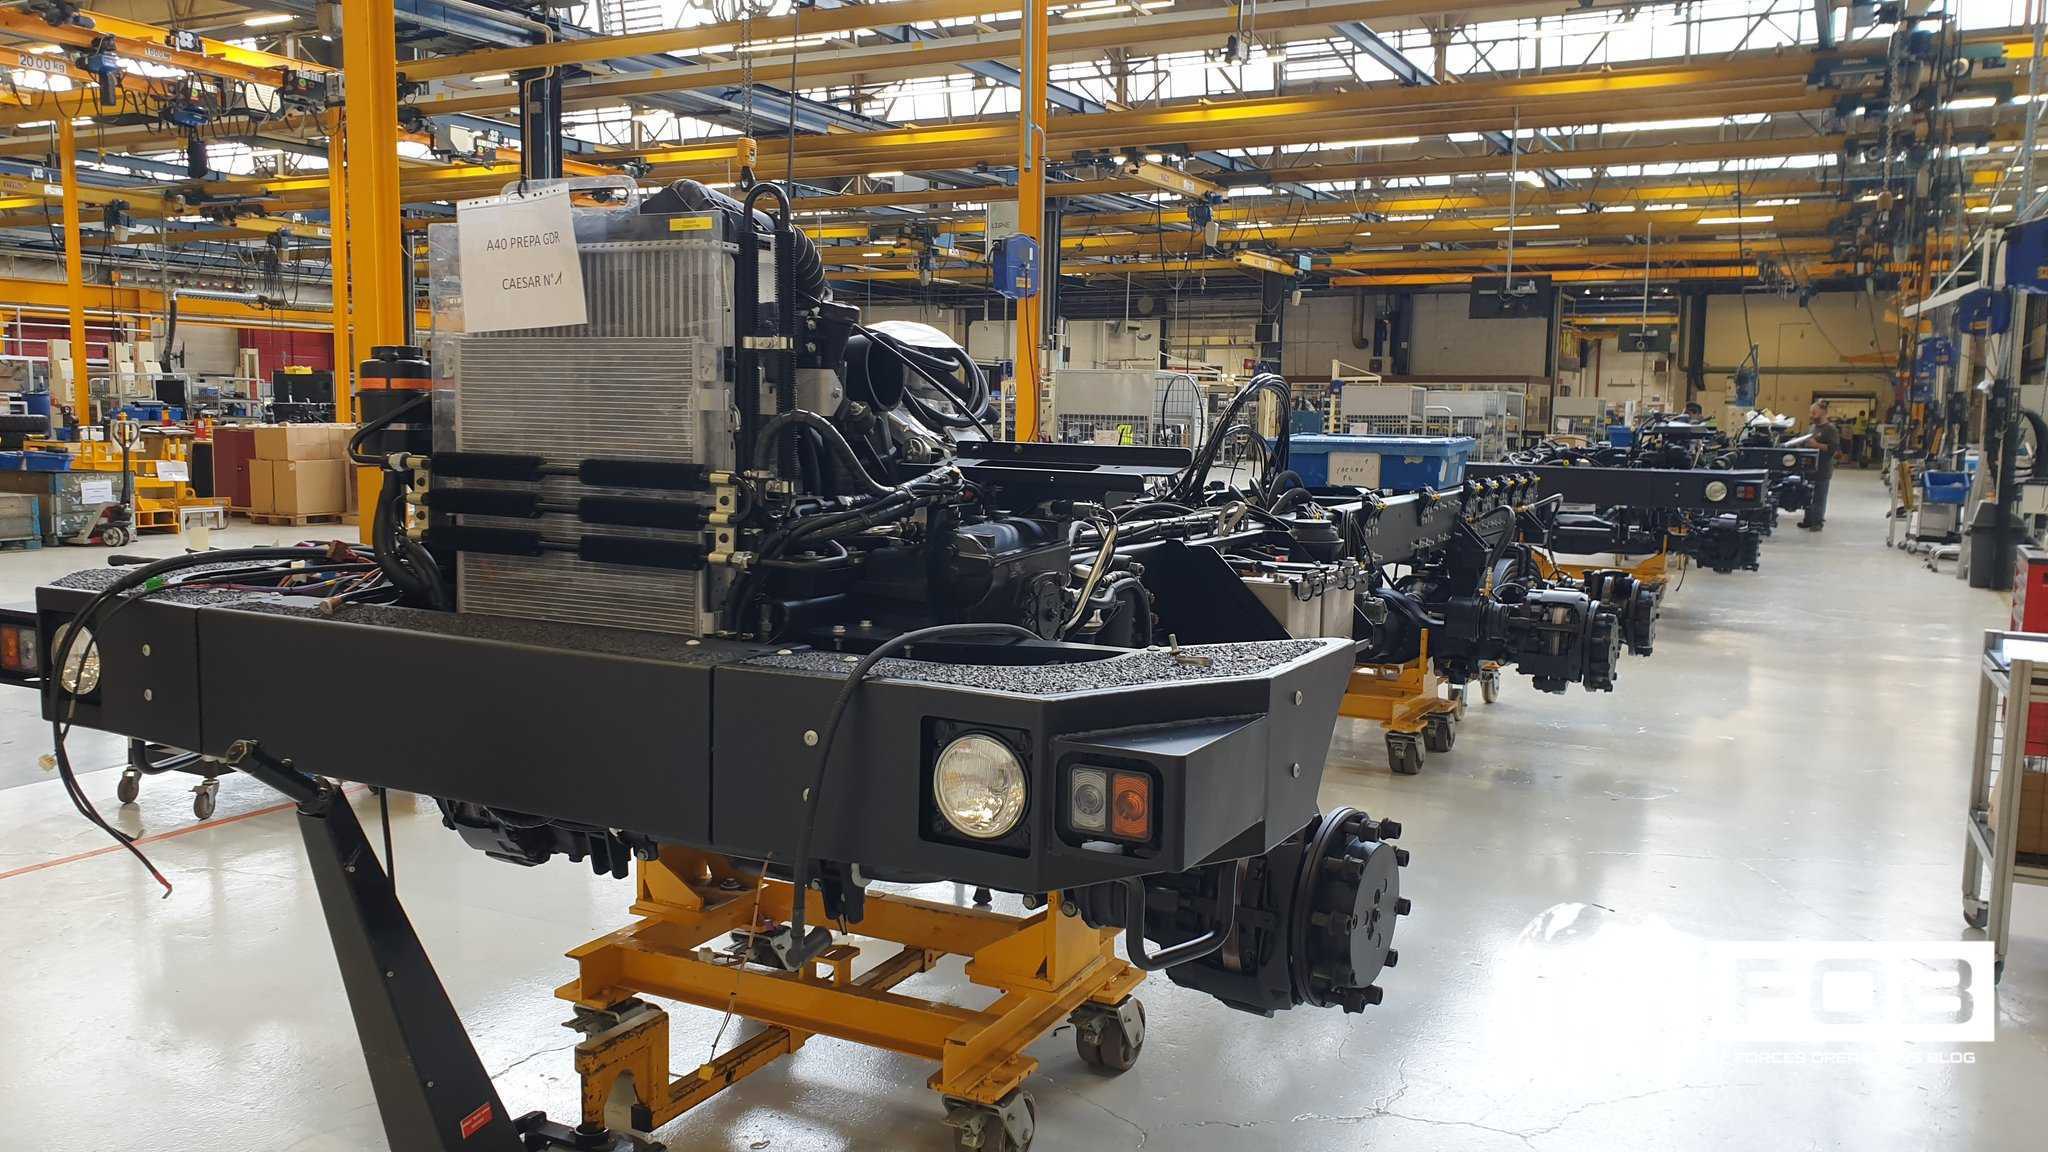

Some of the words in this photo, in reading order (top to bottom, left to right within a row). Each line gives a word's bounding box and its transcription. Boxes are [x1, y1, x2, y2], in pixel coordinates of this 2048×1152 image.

[486, 238, 508, 251] A40
[510, 234, 541, 249] PREPA
[543, 231, 560, 245] GDR
[502, 275, 541, 290] CAESAR
